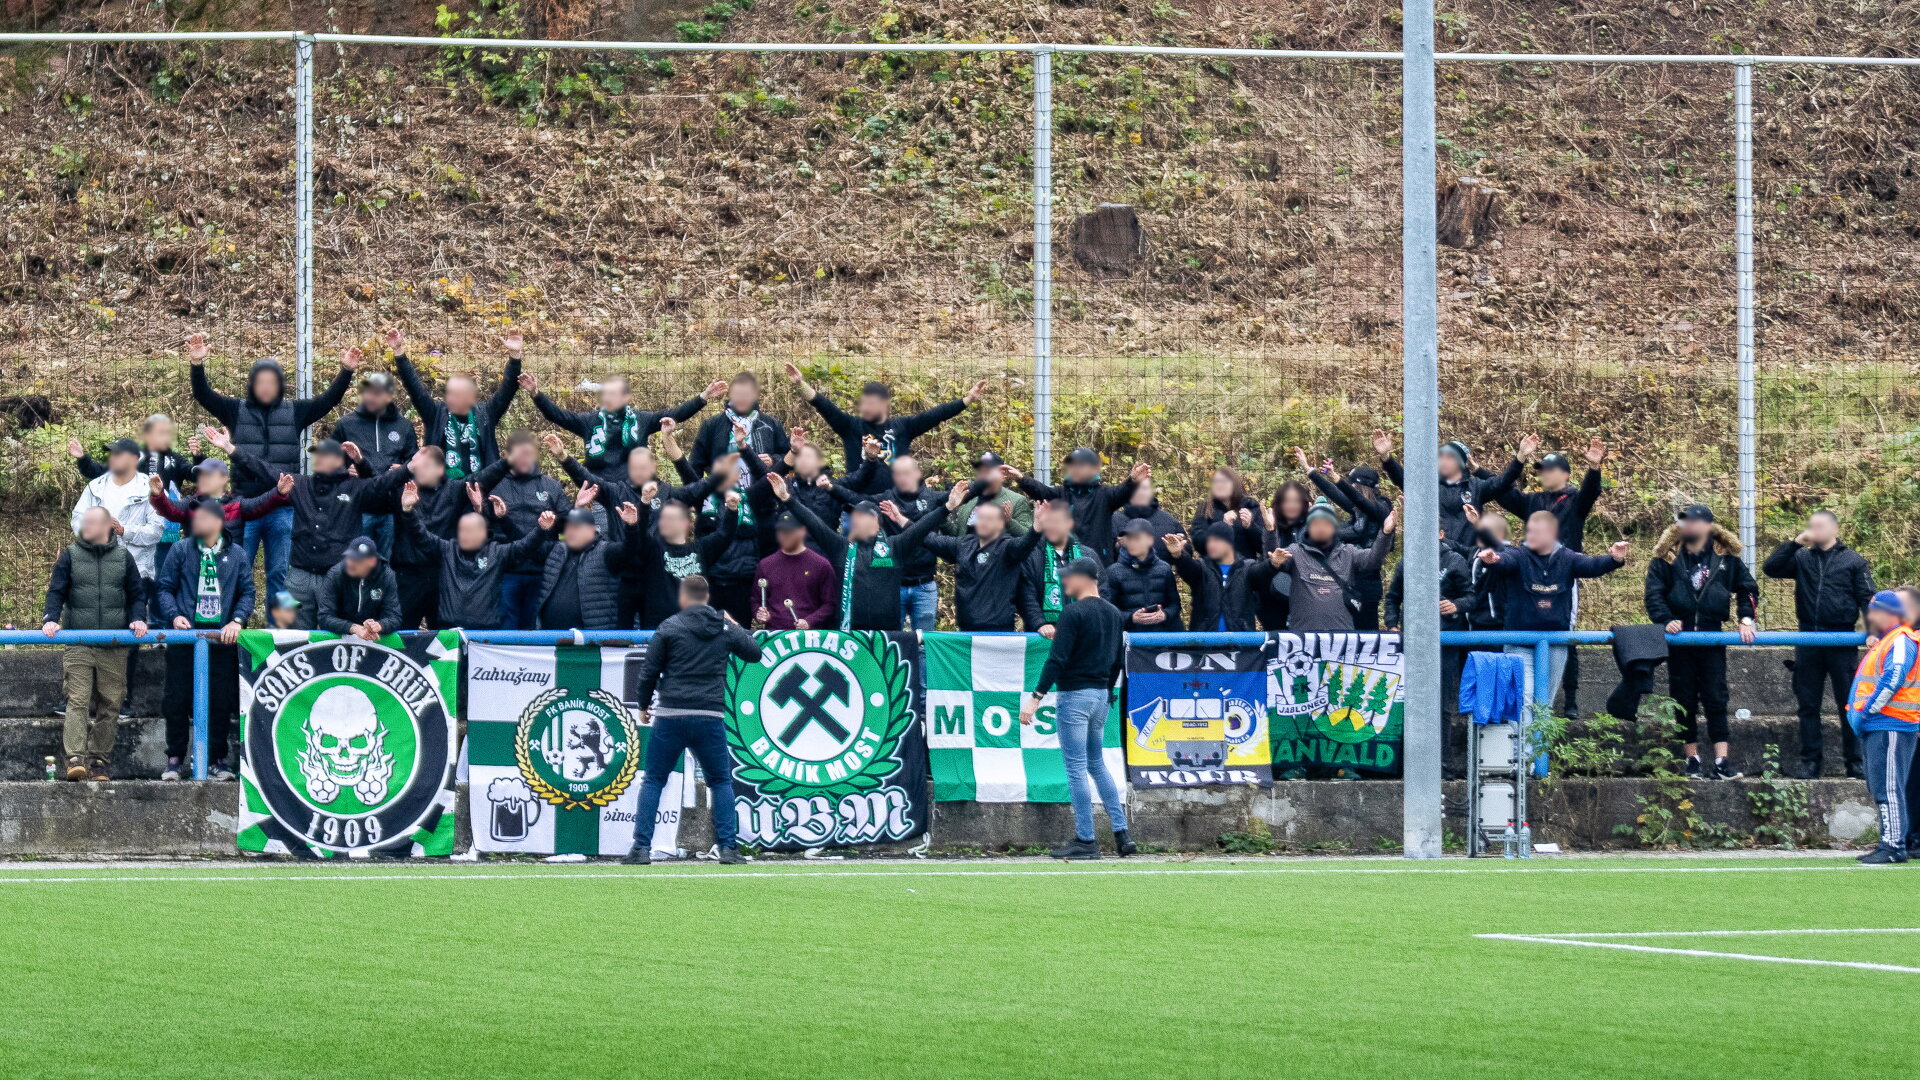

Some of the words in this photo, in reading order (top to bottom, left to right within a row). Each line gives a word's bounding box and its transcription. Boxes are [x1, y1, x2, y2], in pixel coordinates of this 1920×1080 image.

[760, 630, 859, 668] ULTRAS
[1155, 651, 1240, 670] ON
[1278, 632, 1400, 665] DIVIZE
[255, 652, 315, 712] SONS
[331, 644, 366, 672] OF
[376, 653, 438, 716] BRÜX
[470, 666, 551, 686] Zahražany
[545, 705, 559, 717] FK
[557, 698, 586, 711] BANÍK
[586, 702, 611, 720] MOST
[1278, 697, 1327, 714] JABLONEC
[934, 703, 1057, 736] MOS
[750, 736, 821, 783] BANÍK
[824, 726, 881, 781] MOST
[1272, 739, 1394, 766] ANVALD
[568, 783, 589, 792] 1909
[1140, 770, 1261, 785] TOUR
[655, 810, 678, 824] 005
[304, 812, 382, 847] 1909
